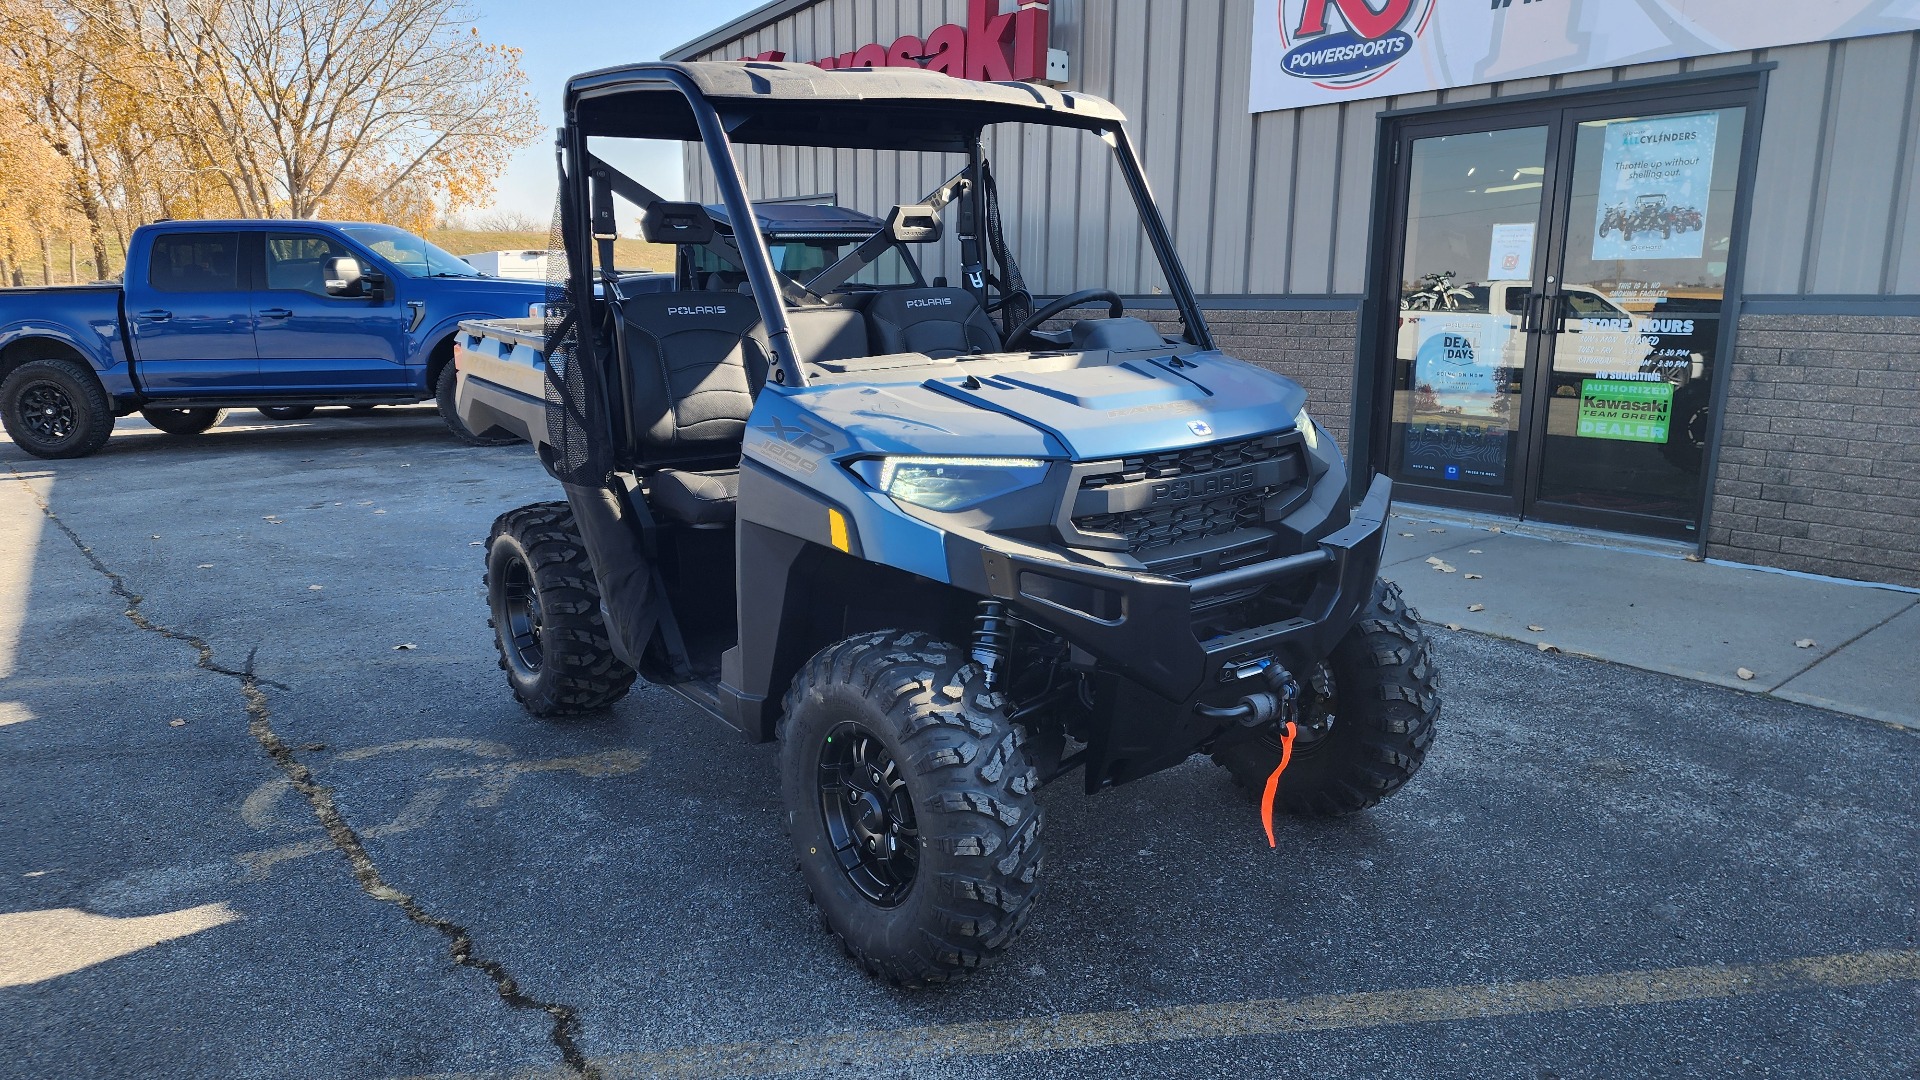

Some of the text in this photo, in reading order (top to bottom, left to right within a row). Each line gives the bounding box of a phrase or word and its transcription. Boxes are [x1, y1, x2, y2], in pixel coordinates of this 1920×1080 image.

[737, 0, 1047, 81] asaki
[1290, 36, 1405, 69] POWERSPORTS
[1615, 157, 1699, 171] Throttle up without
[1629, 169, 1681, 180] shelling out.
[1650, 281, 1661, 289] NO
[1639, 289, 1669, 297] FACILITY
[906, 296, 952, 308] POLARIS
[668, 305, 727, 316] POLARIS
[1580, 318, 1695, 333] STORE HOURS
[1443, 336, 1481, 349] DEAL
[1579, 335, 1595, 343] SUN
[1624, 336, 1660, 346] CLOSED
[1447, 349, 1475, 360] DAYS
[1578, 346, 1595, 354] TUES
[1601, 346, 1614, 354] FRI
[1675, 349, 1691, 357] PM
[1577, 356, 1615, 365] SATURDAY
[1674, 360, 1689, 368] PM
[1595, 370, 1661, 382] NO SOLICITING
[1585, 383, 1670, 395] AUTHORIZED
[1583, 395, 1668, 413] Kawasaki
[1583, 410, 1667, 422] TEAM GREEN
[756, 415, 836, 455] XP
[1580, 420, 1665, 439] DEALER
[1152, 471, 1254, 505] POLARIS
